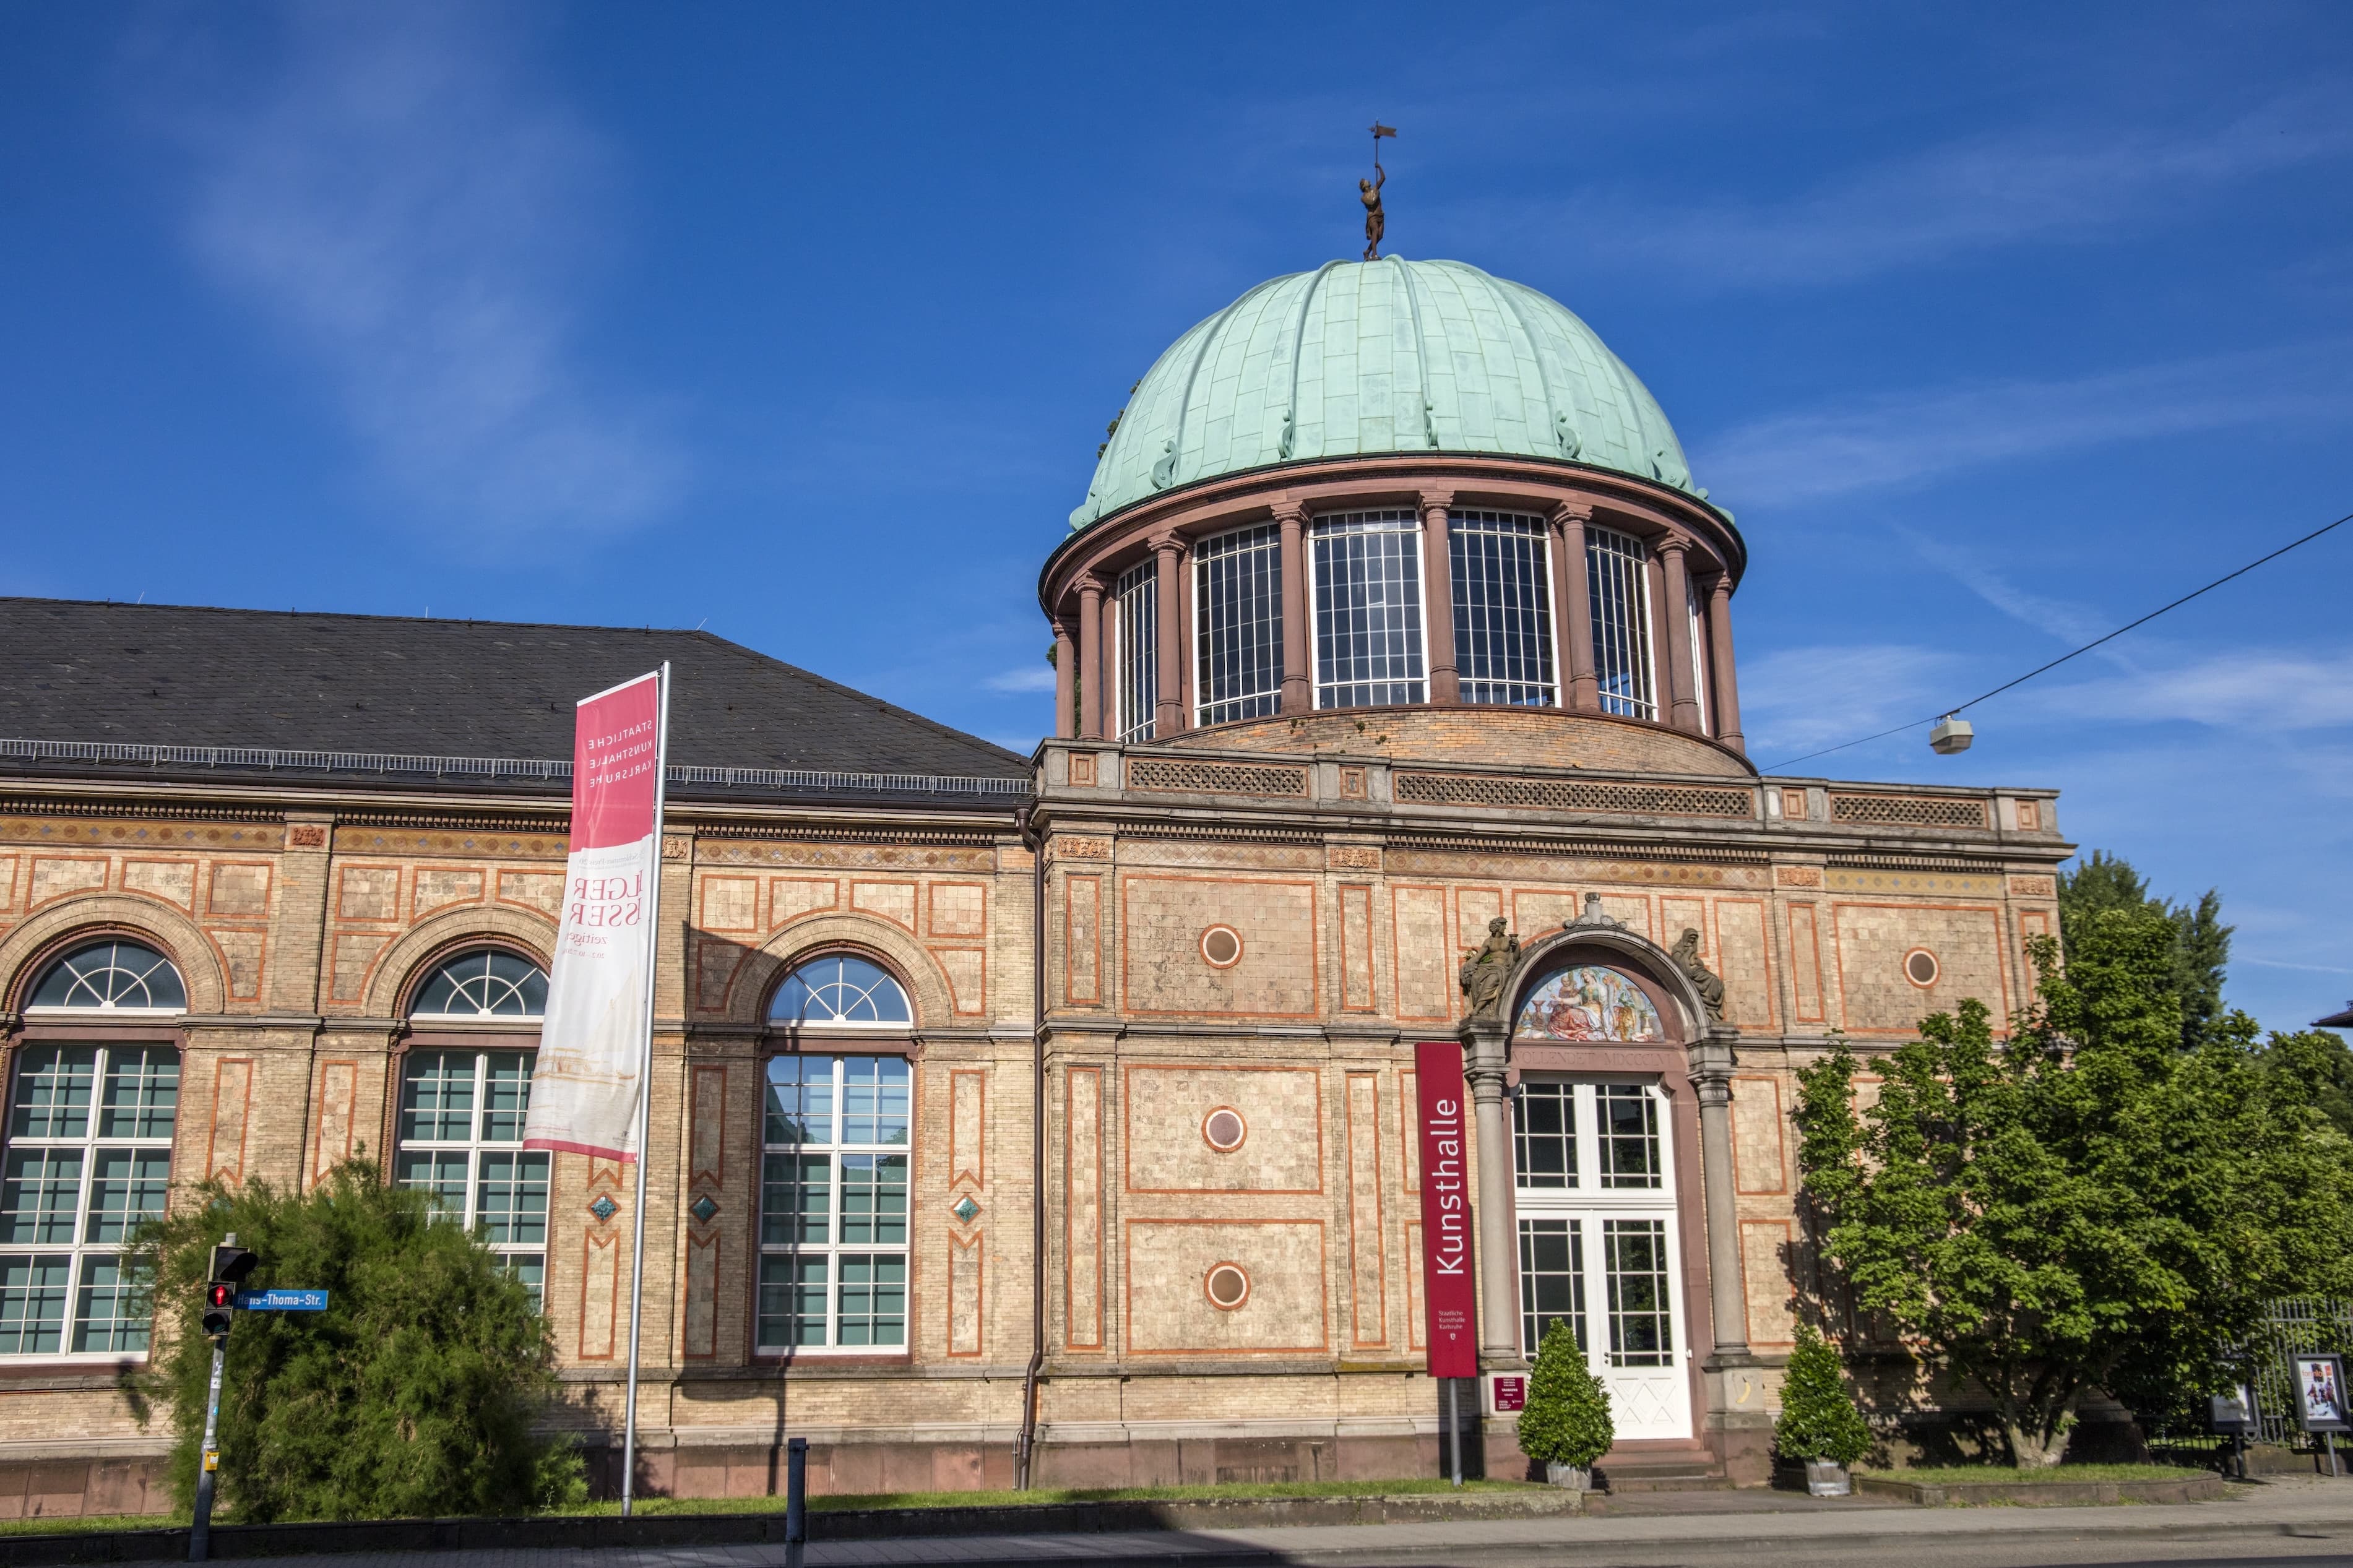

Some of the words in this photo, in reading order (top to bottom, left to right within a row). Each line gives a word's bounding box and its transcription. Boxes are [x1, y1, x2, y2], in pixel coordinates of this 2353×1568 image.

[1511, 1051, 1595, 1065] VOLLENDET
[1430, 1099, 1464, 1274] Kunsthalle
[237, 1293, 321, 1306] Hans-Thoma-Str.
